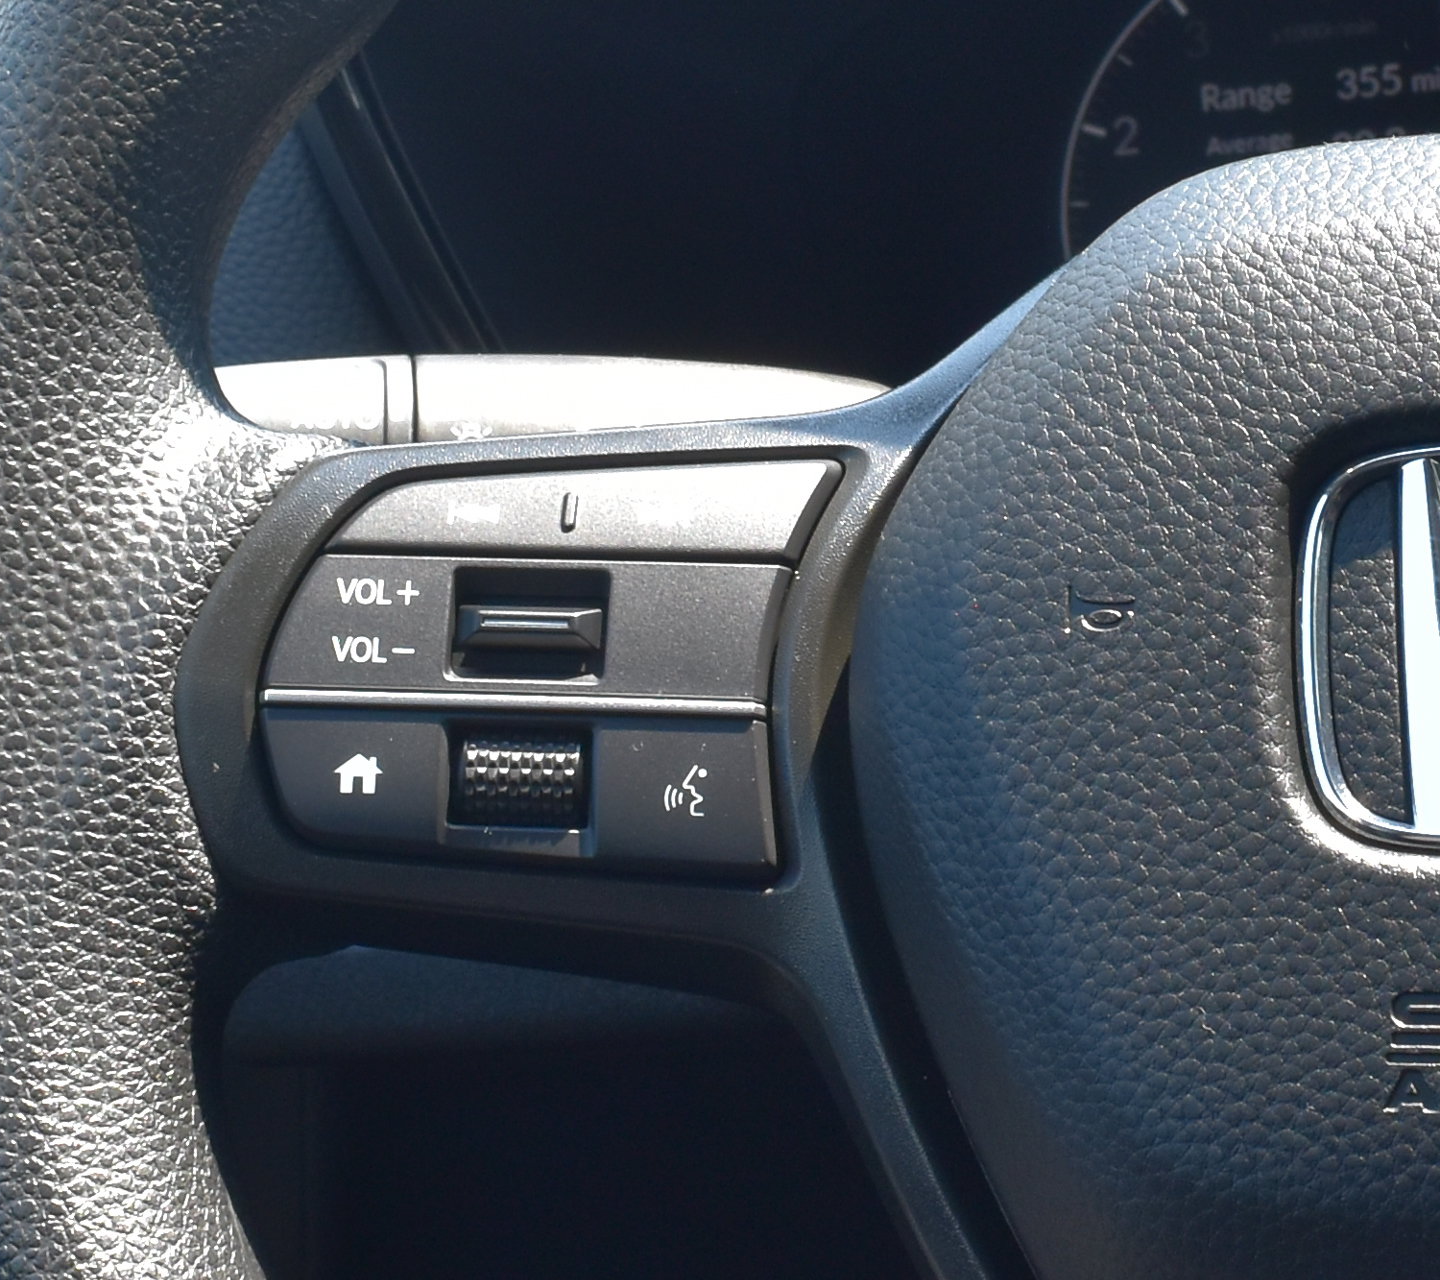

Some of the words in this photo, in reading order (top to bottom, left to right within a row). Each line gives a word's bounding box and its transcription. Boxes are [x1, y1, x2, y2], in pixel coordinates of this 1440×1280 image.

[1200, 82, 1293, 113] Range
[1337, 64, 1403, 100] 355
[1113, 117, 1139, 156] 2
